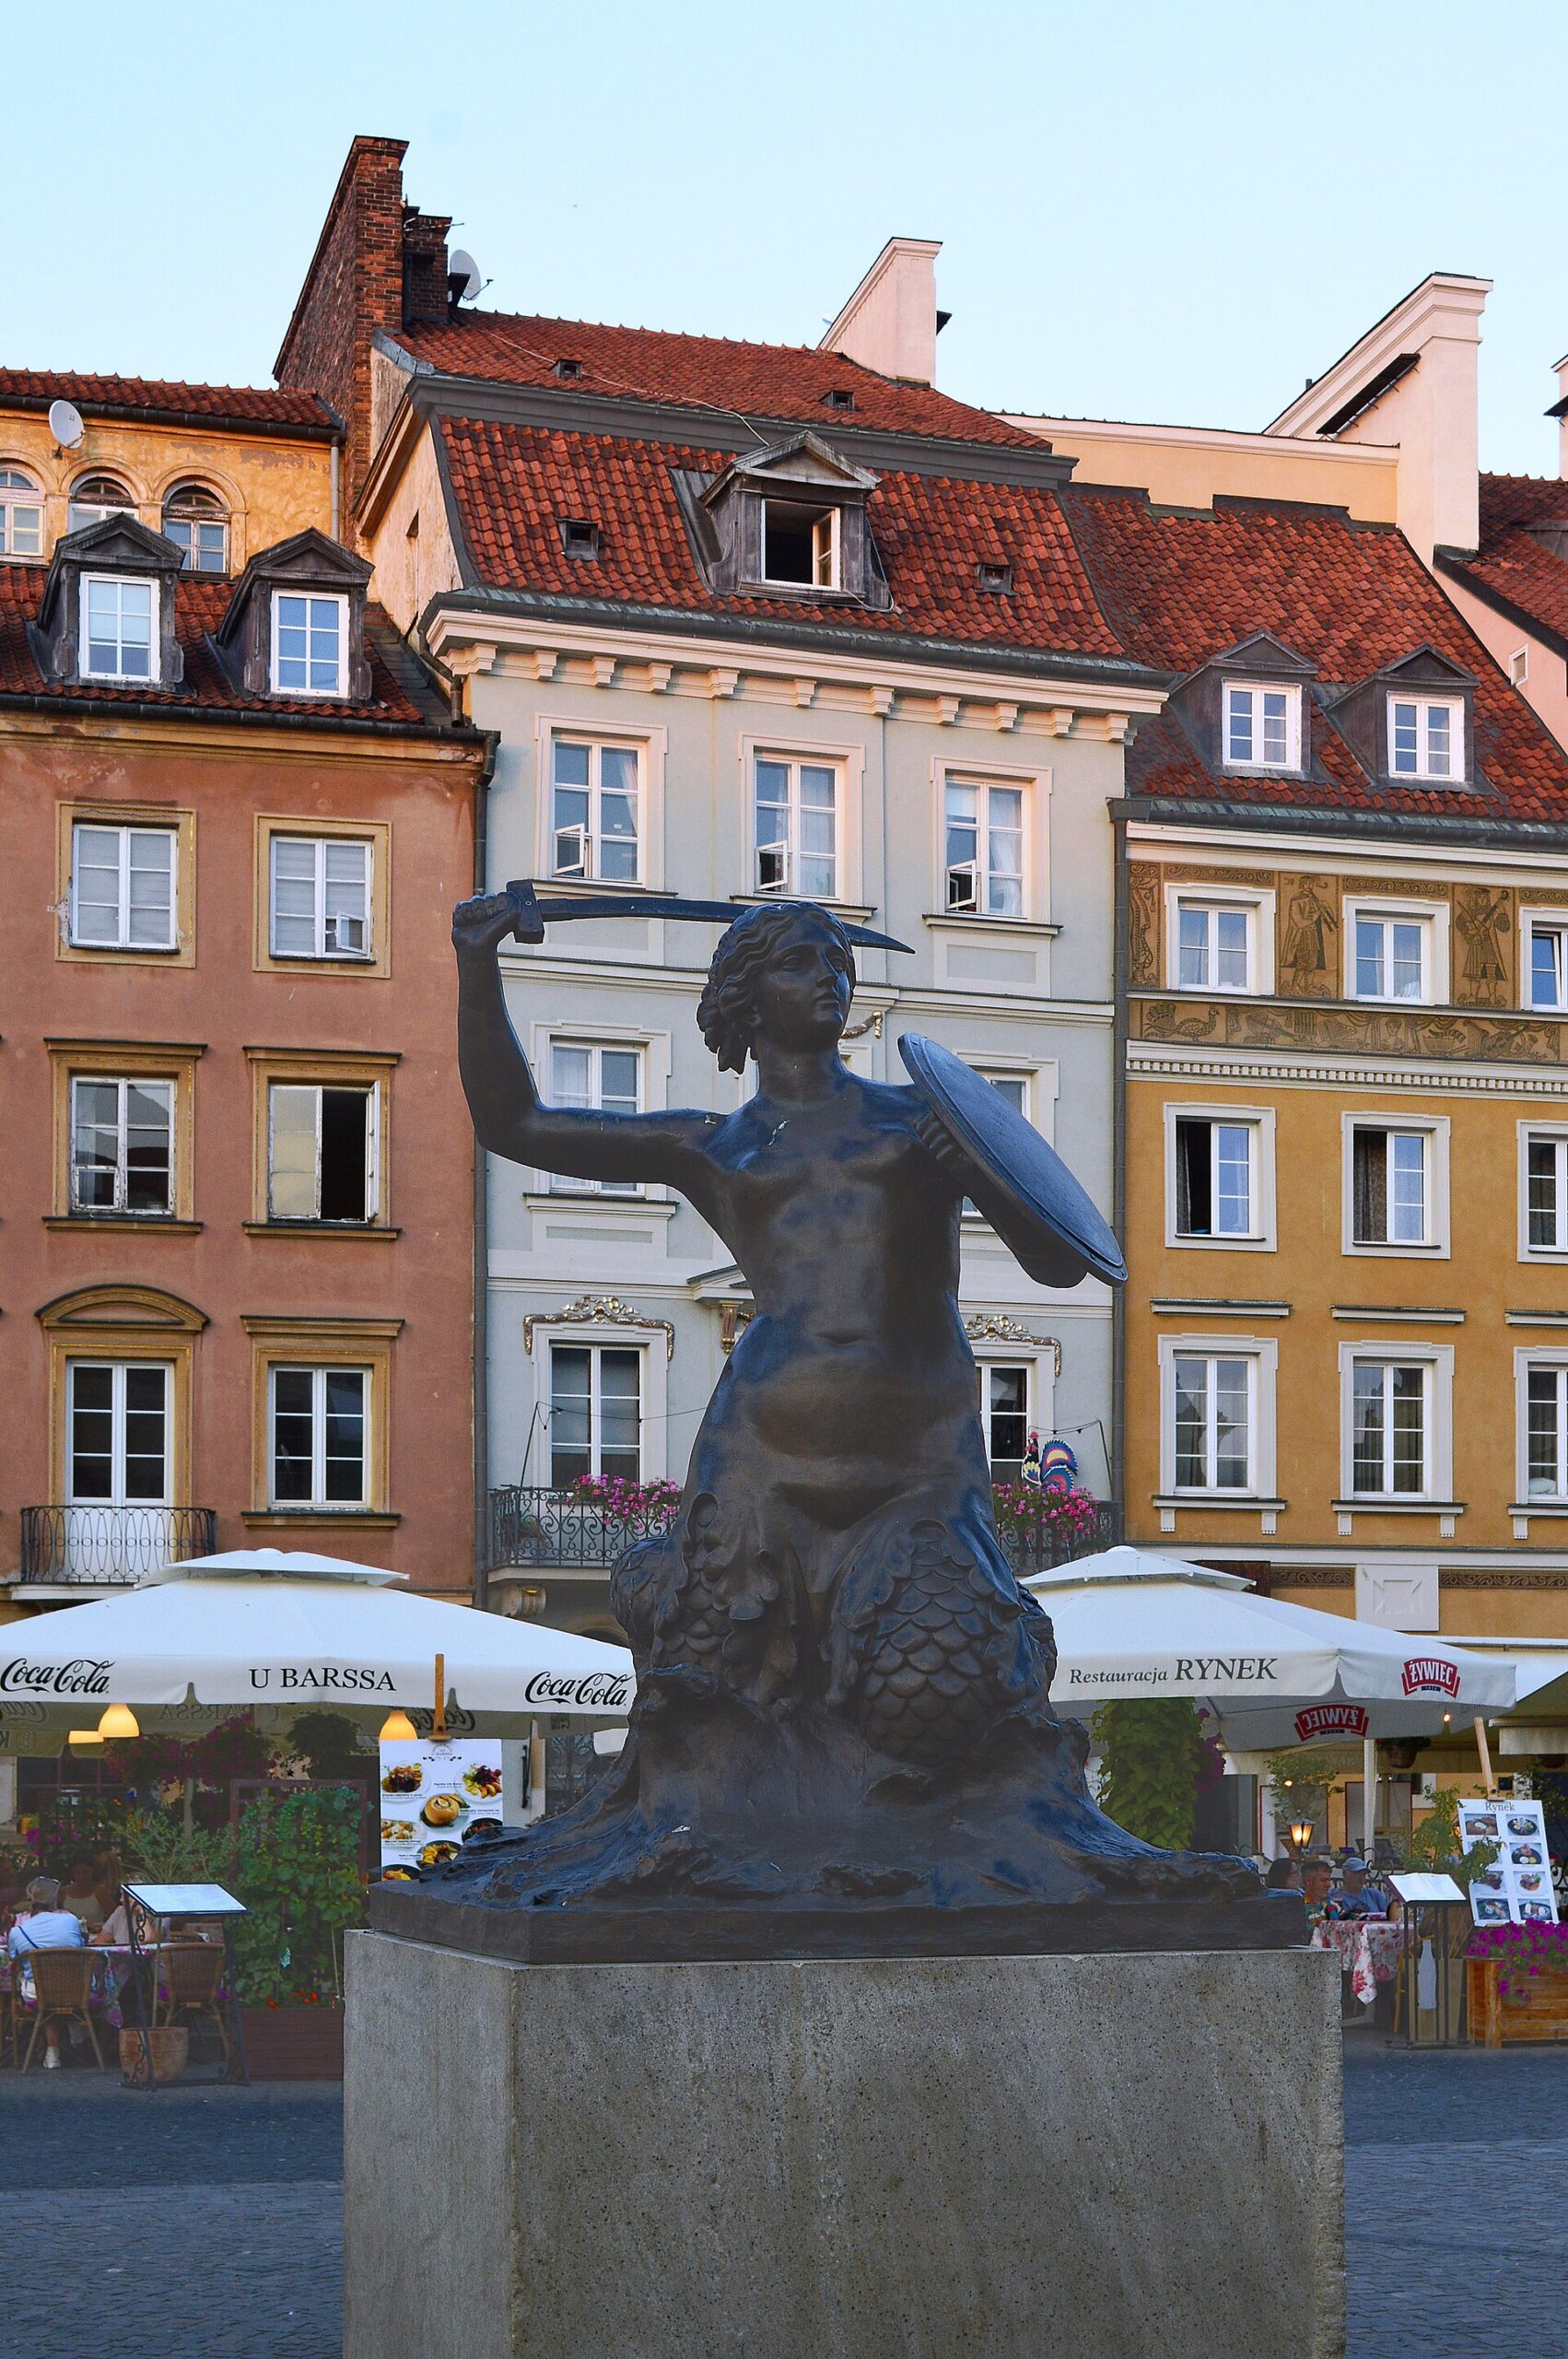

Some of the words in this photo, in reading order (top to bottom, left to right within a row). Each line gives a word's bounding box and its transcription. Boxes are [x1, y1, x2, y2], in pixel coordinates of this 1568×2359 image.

[0, 1658, 117, 1694] Coca-Cola
[249, 1668, 272, 1689] U
[280, 1667, 397, 1691] BARSSA
[1069, 1667, 1168, 1684] Restauracja
[1174, 1658, 1279, 1681] RYNEK
[1409, 1661, 1454, 1685] ŻYWIEC
[525, 1671, 634, 1707] Coca-Cola
[1485, 1802, 1515, 1813] Rynek
